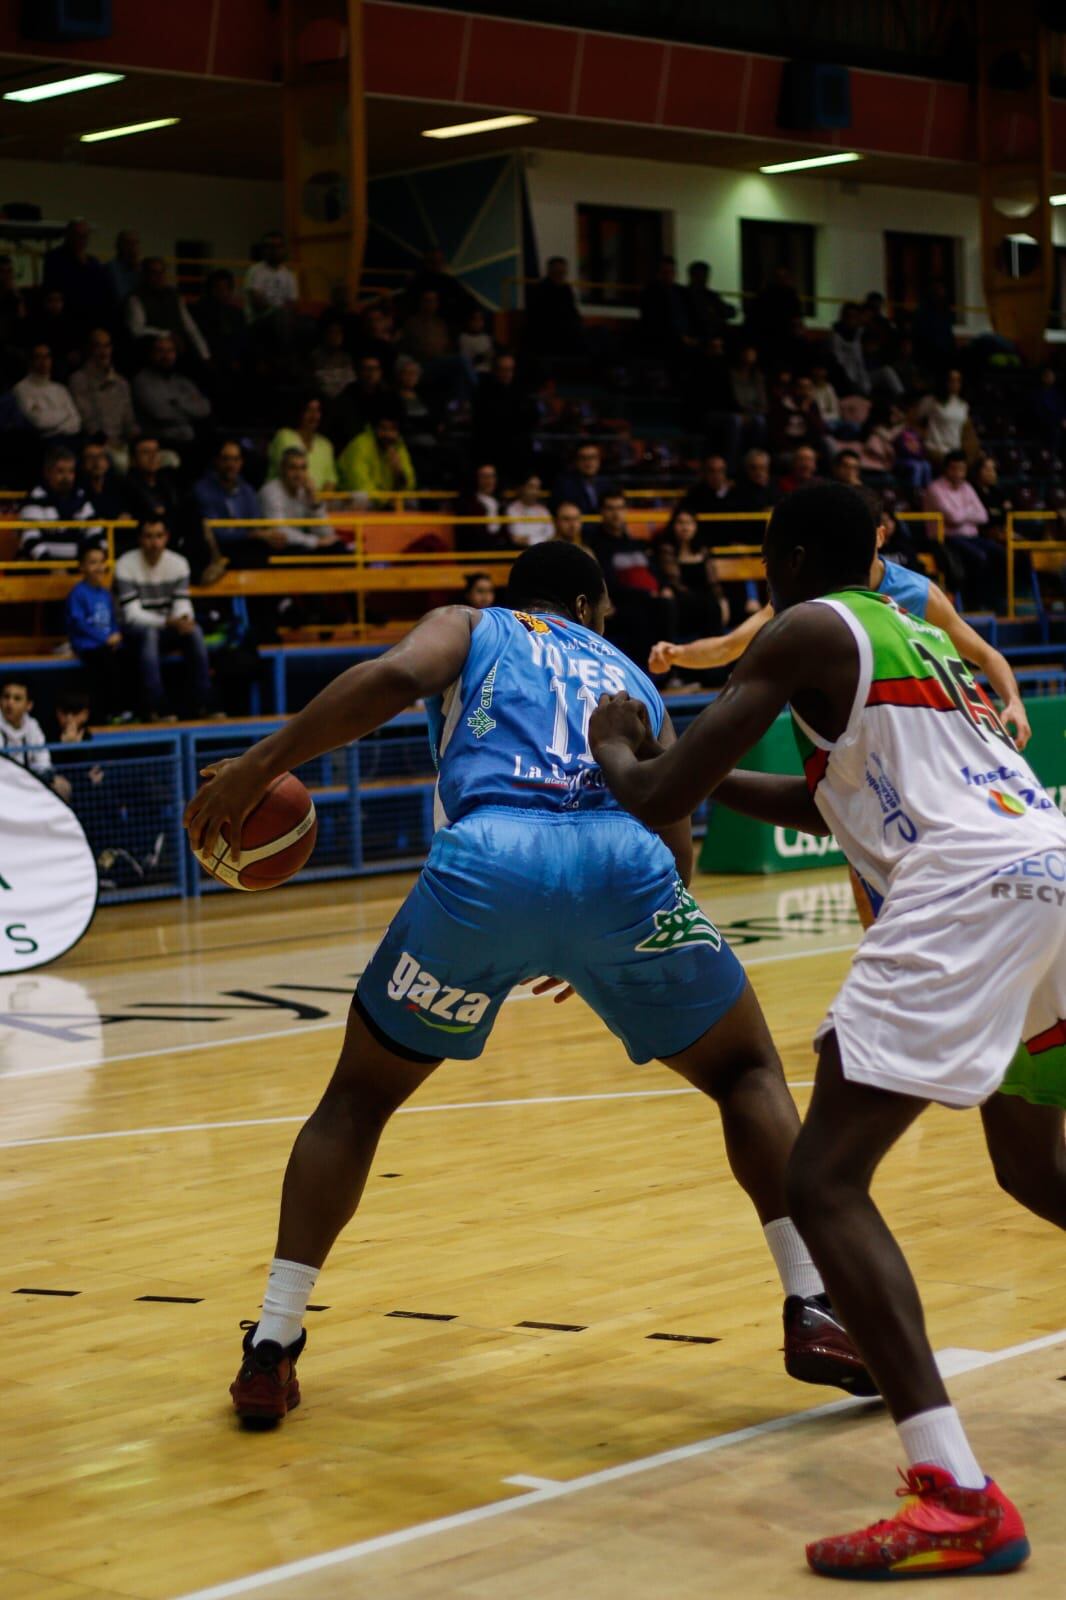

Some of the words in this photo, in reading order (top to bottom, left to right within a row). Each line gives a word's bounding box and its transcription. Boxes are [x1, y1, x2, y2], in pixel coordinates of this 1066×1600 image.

[546, 676, 597, 764] 11
[513, 755, 542, 778] La
[388, 952, 491, 1023] gaza
